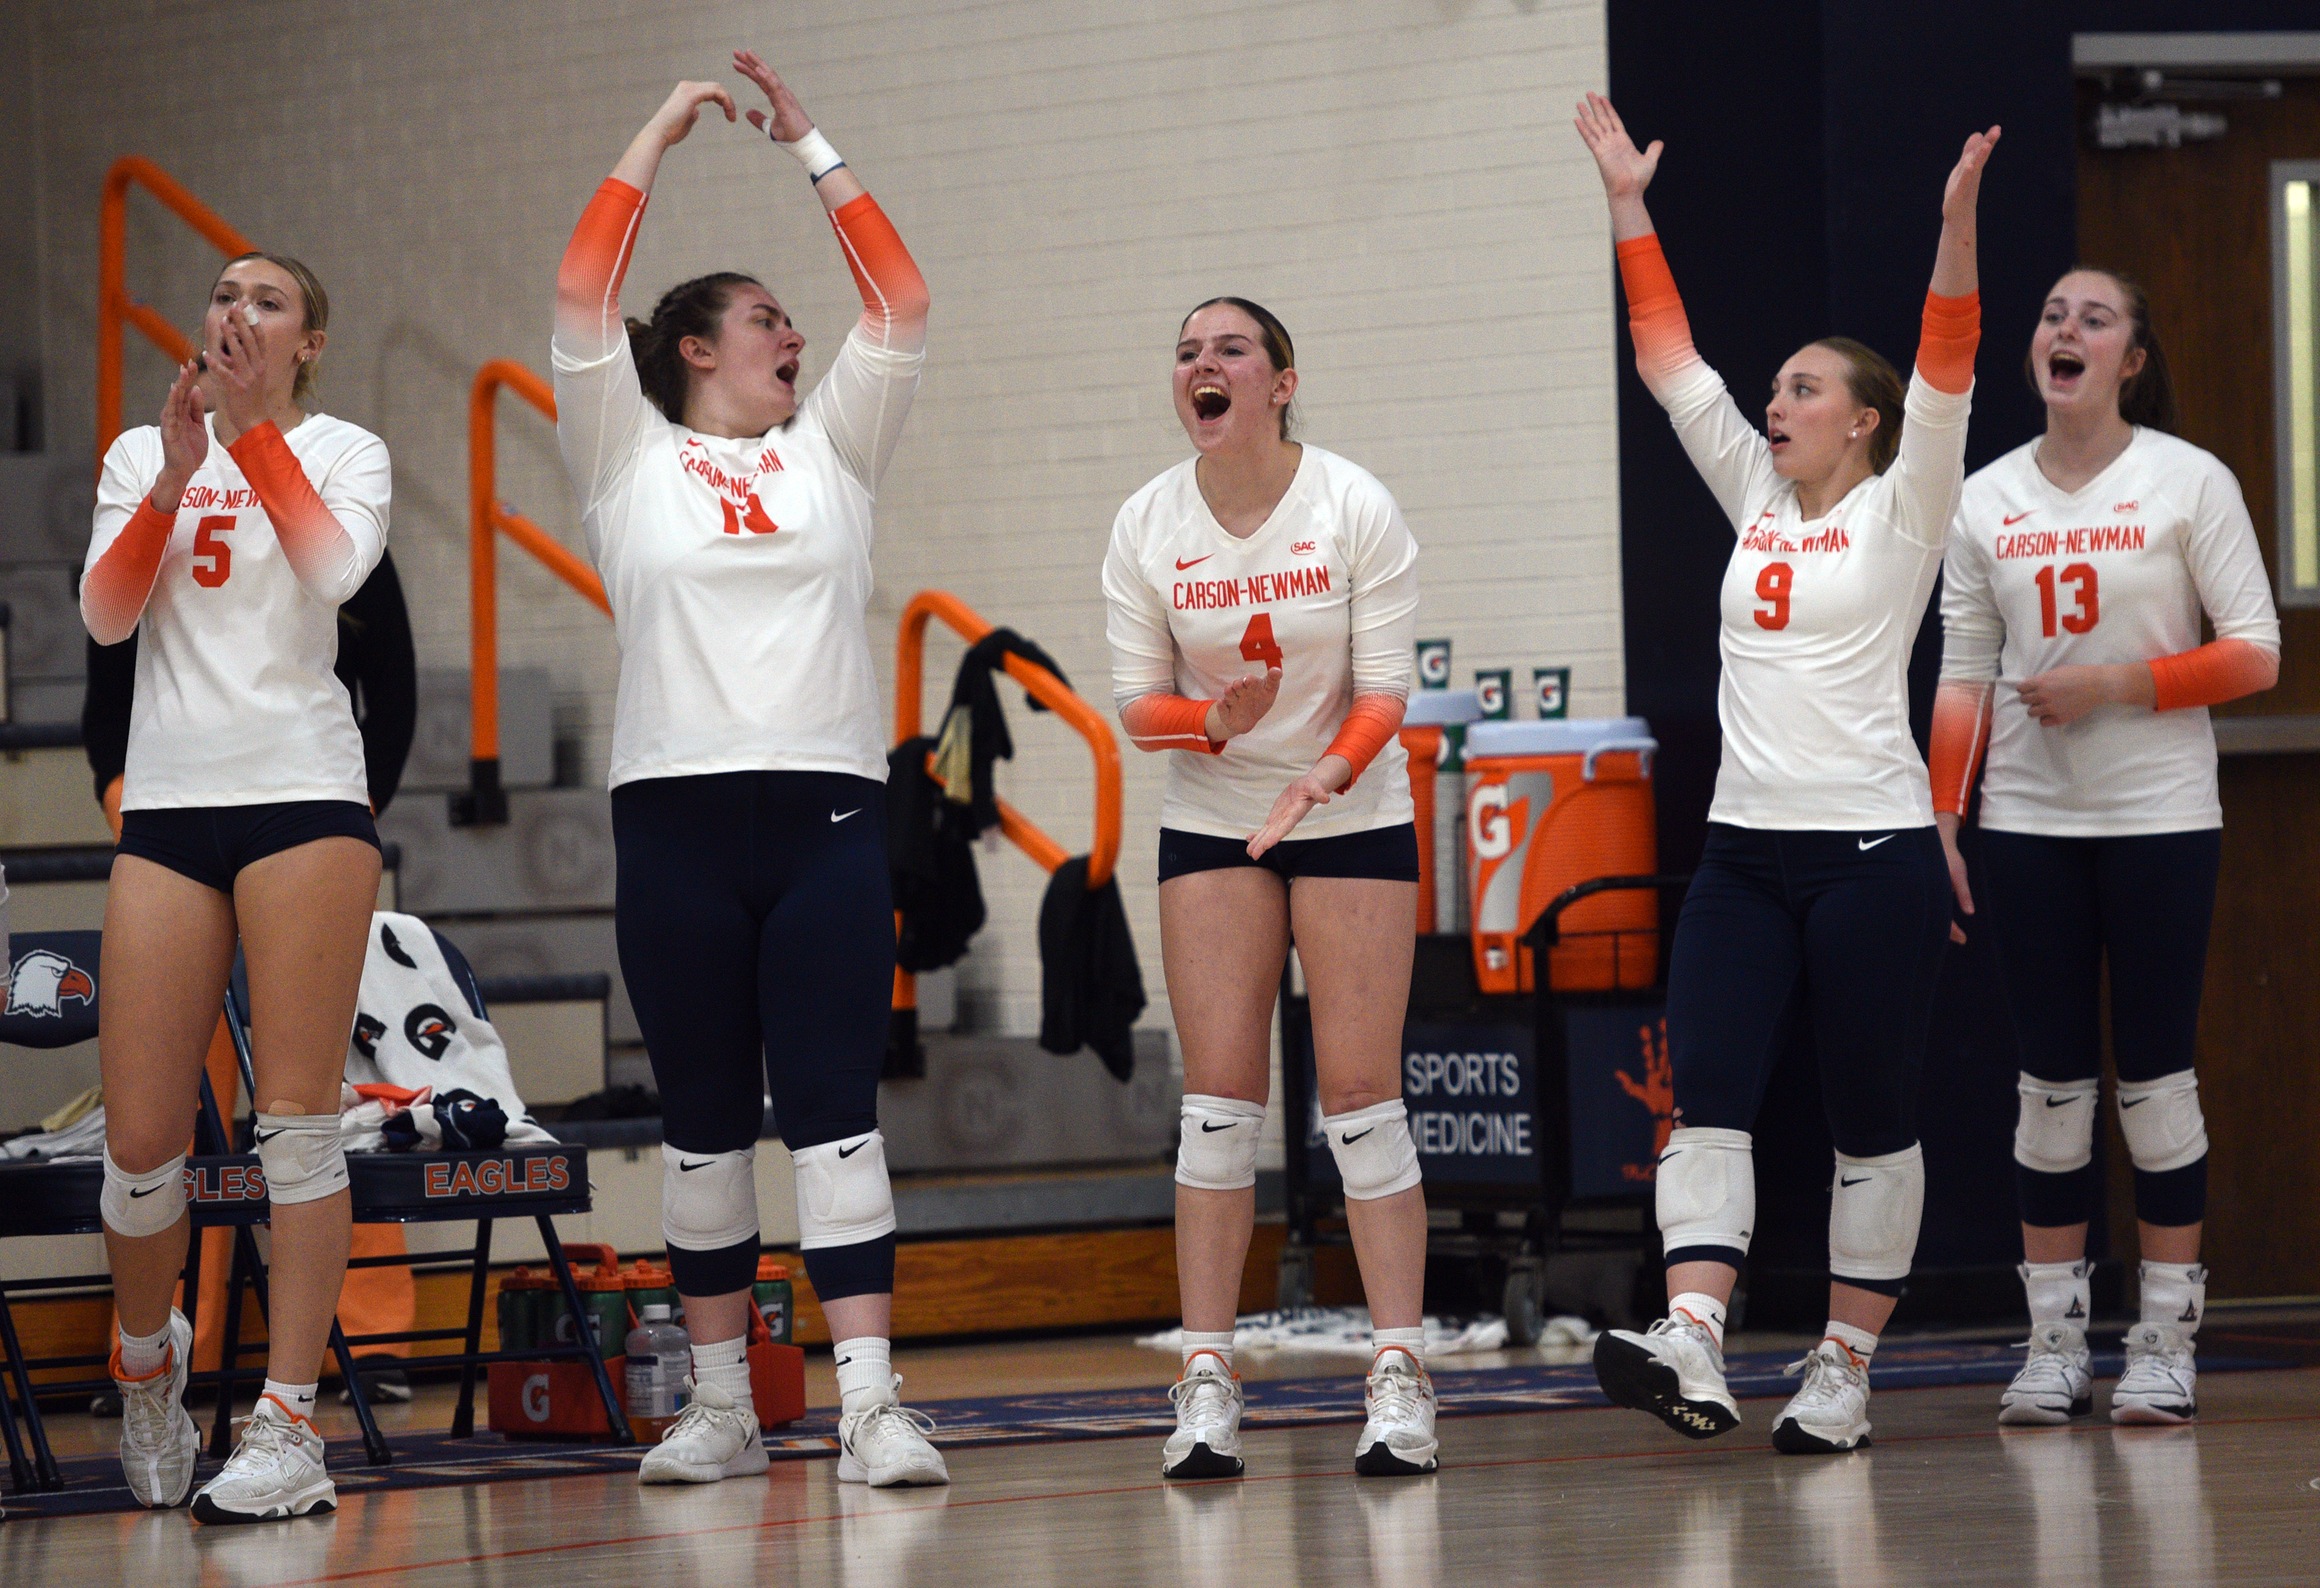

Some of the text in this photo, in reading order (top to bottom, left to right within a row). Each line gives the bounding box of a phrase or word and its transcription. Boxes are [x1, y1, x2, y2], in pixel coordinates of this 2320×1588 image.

[191, 514, 238, 588] 5
[1292, 541, 1317, 553] SAC
[1995, 525, 2146, 560] CARSON-NEWMAN
[1173, 565, 1332, 610] CARSON-NEWMAN
[1753, 561, 1795, 631] 9
[2034, 562, 2100, 639] 13
[1239, 612, 1284, 672] 4
[1471, 785, 1512, 860] G
[1405, 1053, 1521, 1097] SPORTS
[423, 1156, 570, 1198] EAGLES
[521, 1374, 549, 1423] G
